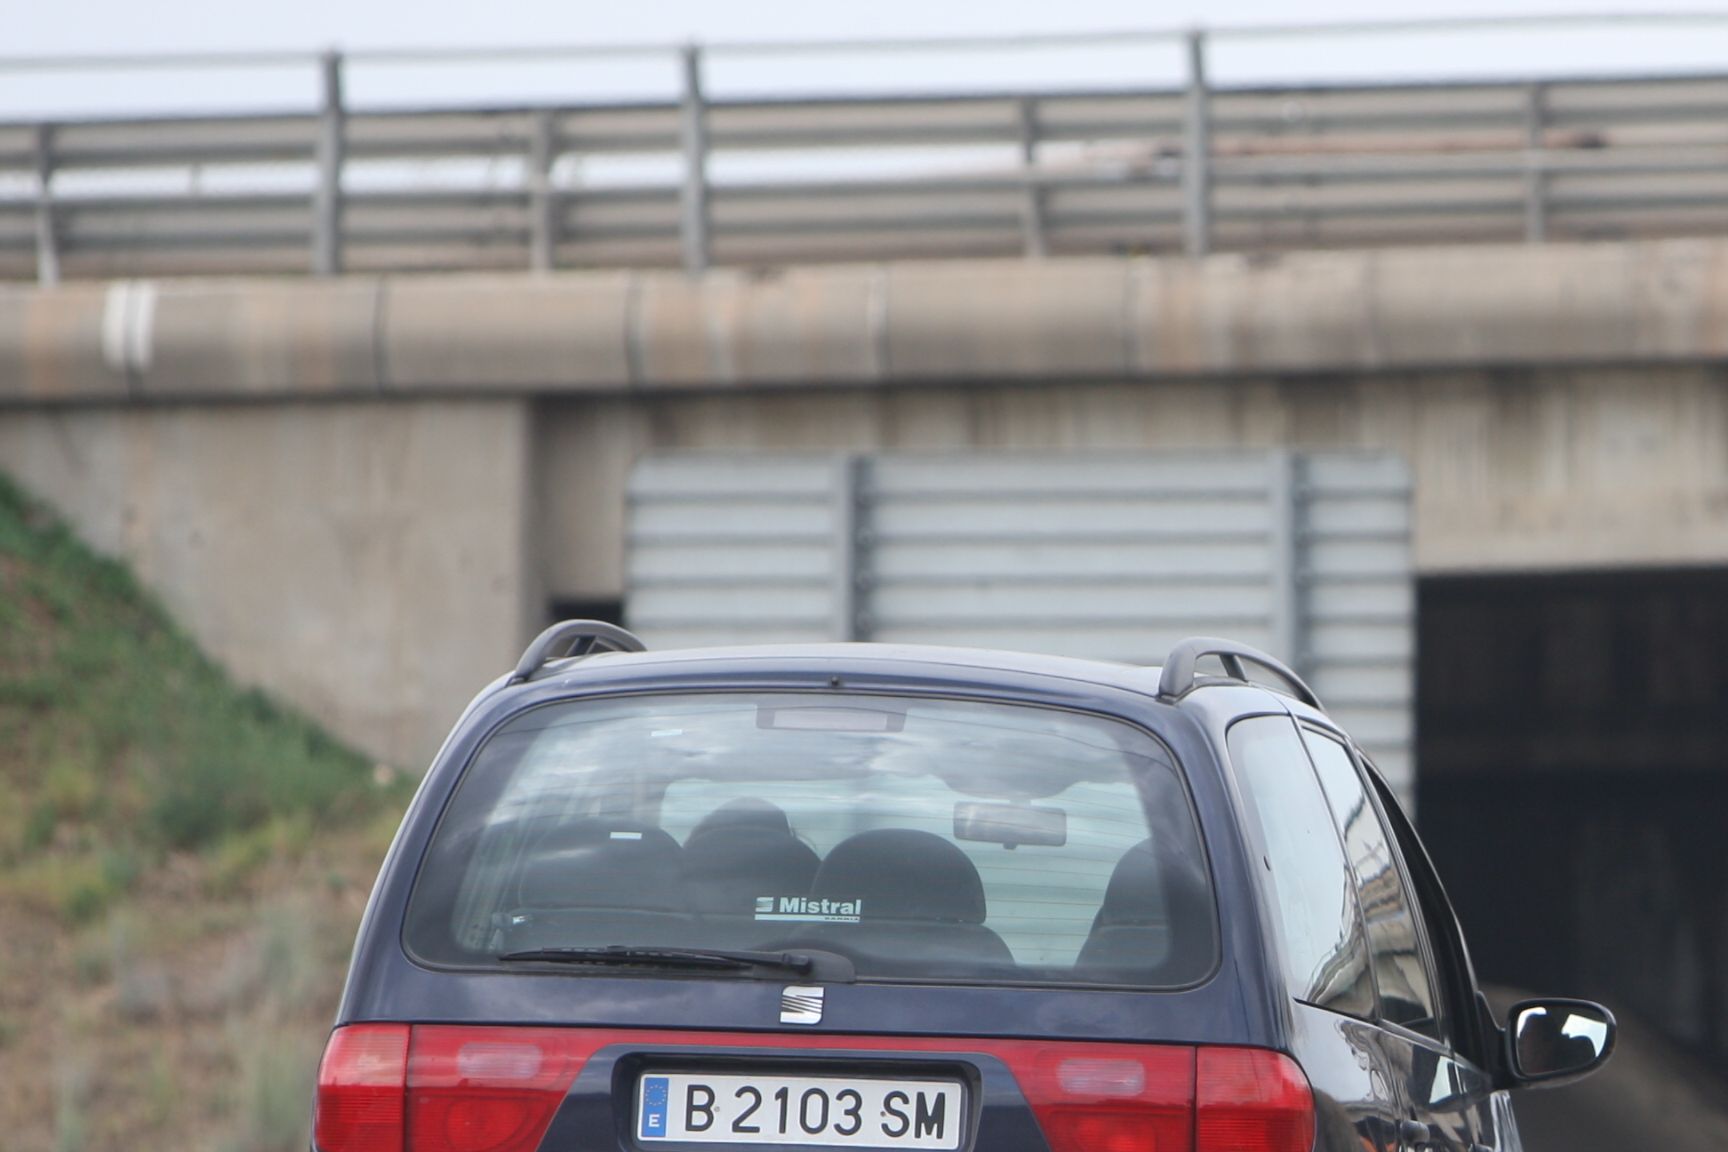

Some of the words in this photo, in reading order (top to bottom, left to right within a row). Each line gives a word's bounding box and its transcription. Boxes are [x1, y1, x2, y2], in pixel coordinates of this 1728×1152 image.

[779, 897, 861, 915] Mistral
[648, 1113, 660, 1128] E
[685, 1084, 716, 1132] B
[731, 1085, 862, 1136] 2103
[881, 1090, 946, 1140] SM
